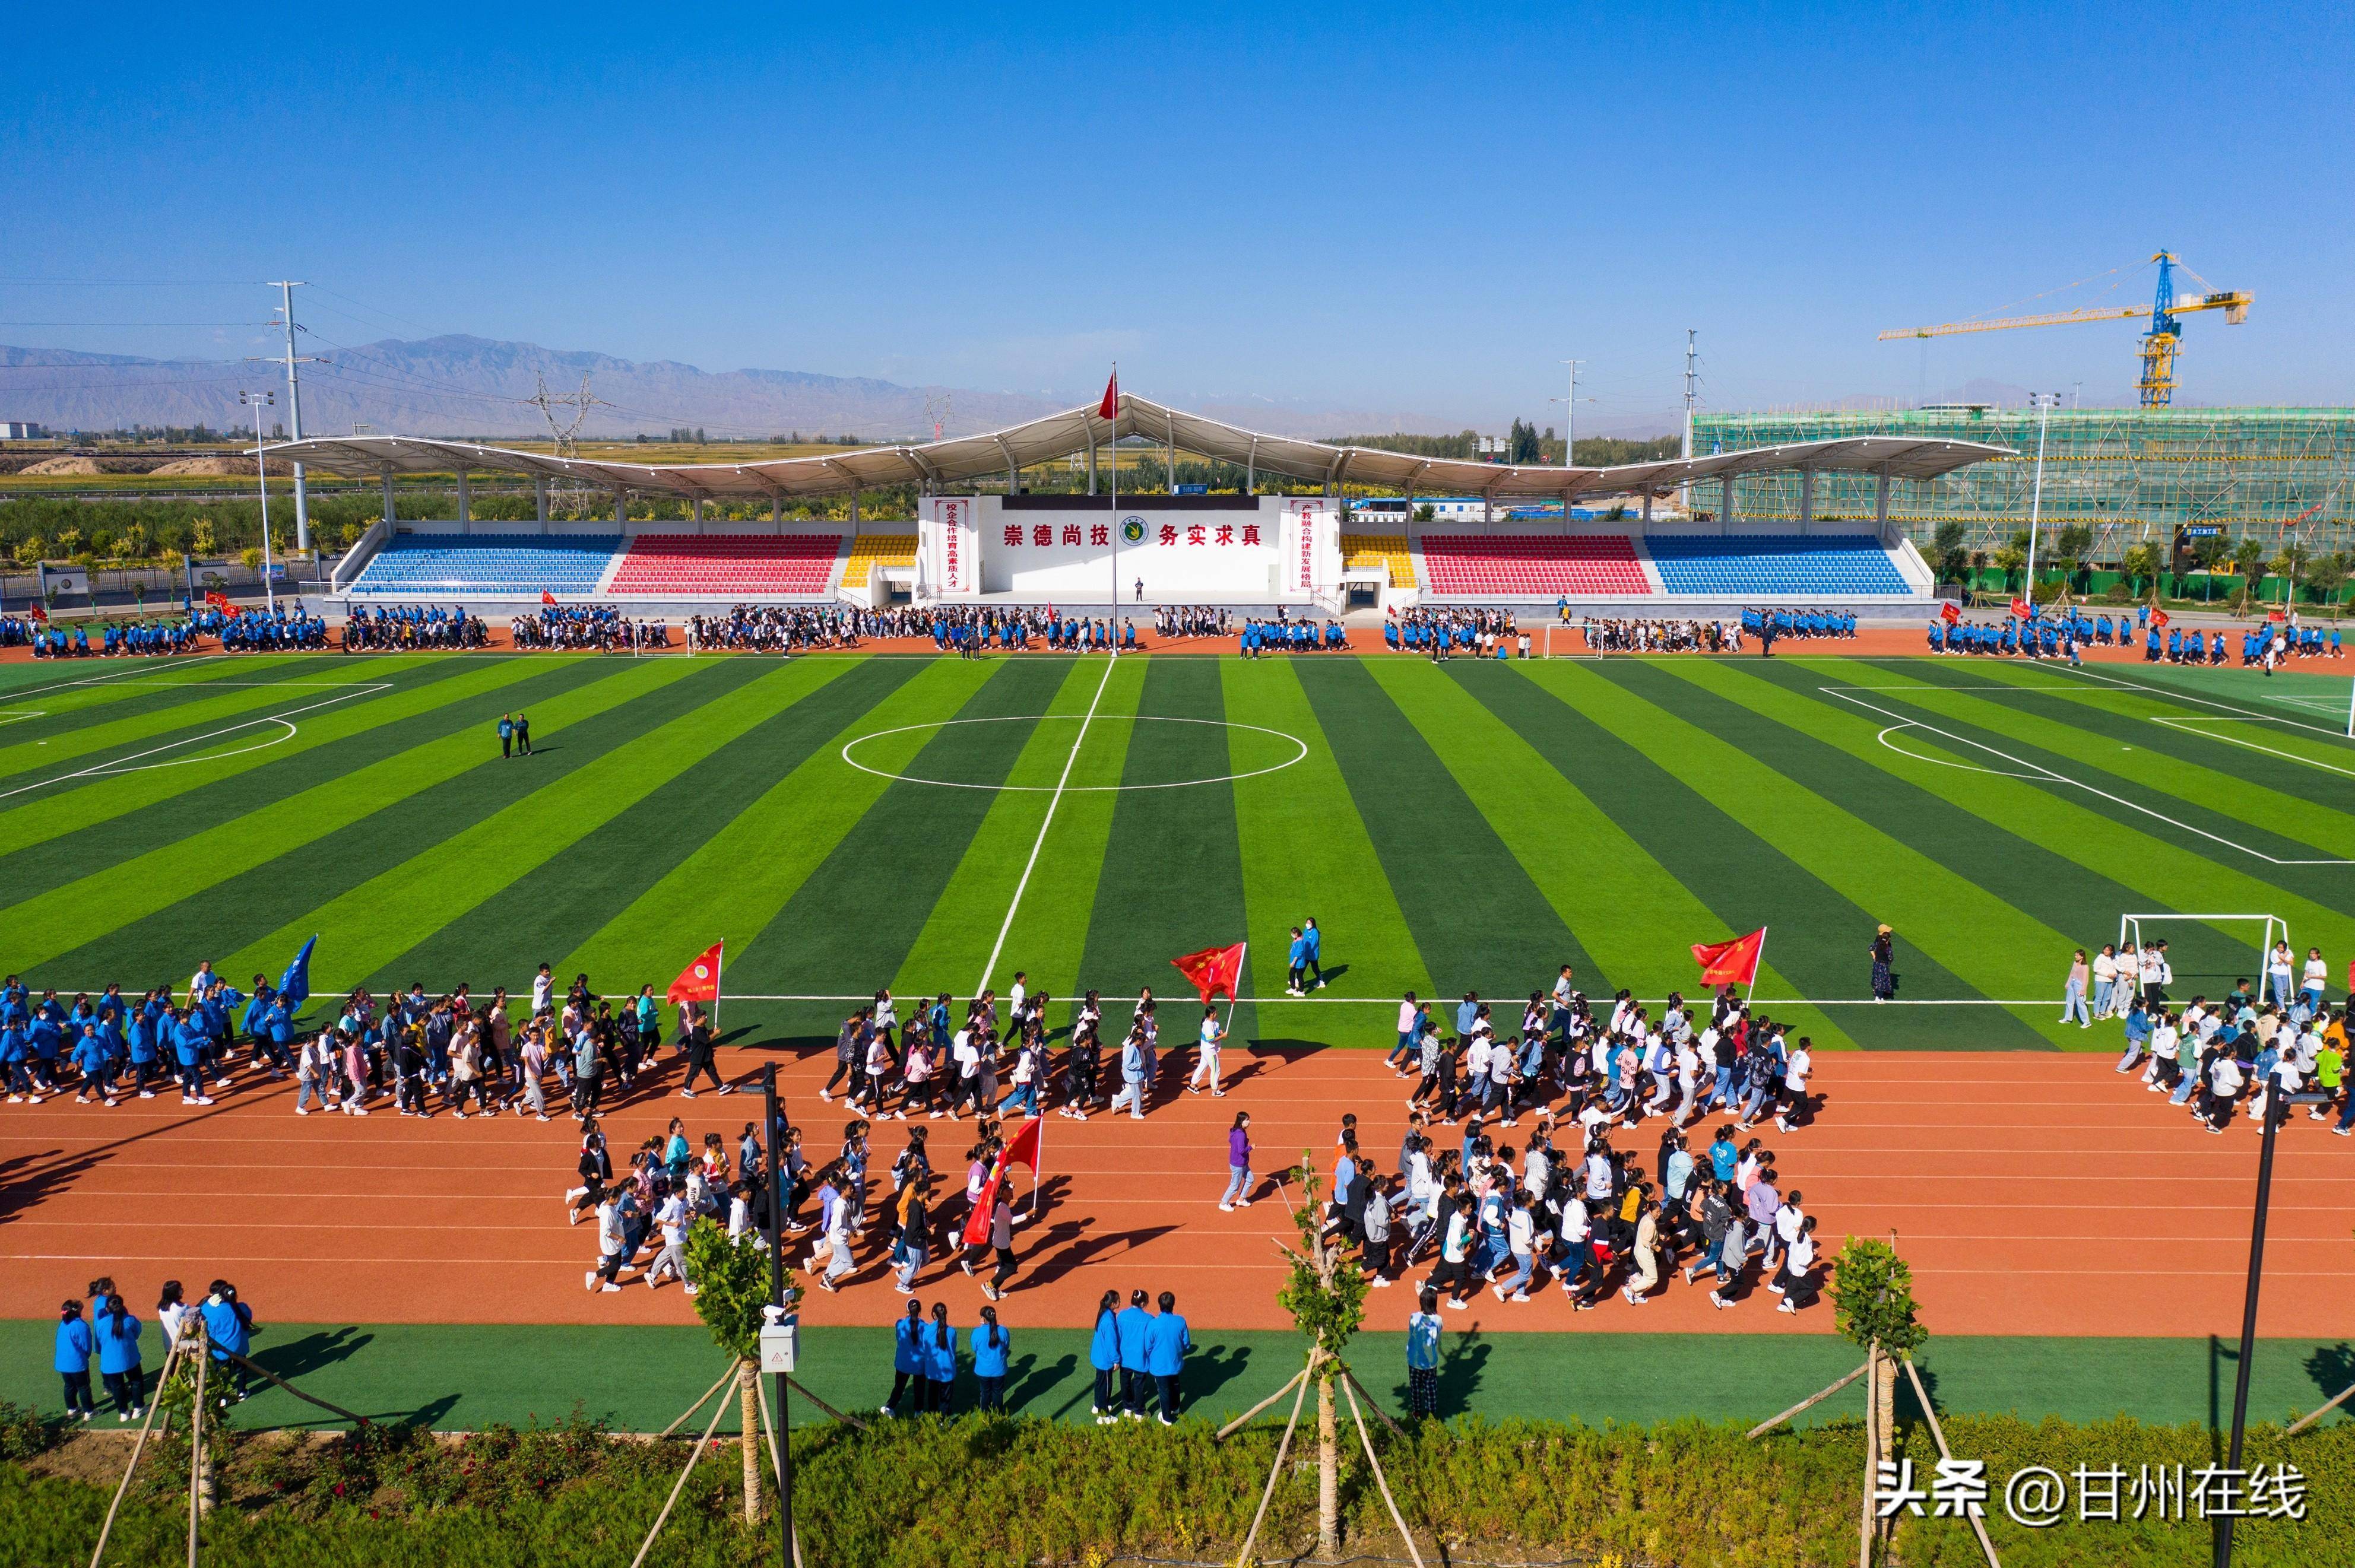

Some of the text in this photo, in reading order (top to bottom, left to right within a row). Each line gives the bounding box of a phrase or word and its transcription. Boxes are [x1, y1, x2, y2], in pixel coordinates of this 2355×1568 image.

[946, 503, 959, 588] 校企合作培育高素质人才
[1004, 524, 1261, 547] 崇德尚技 务实求真
[1301, 504, 1313, 588] 产教融合构建新发展格局
